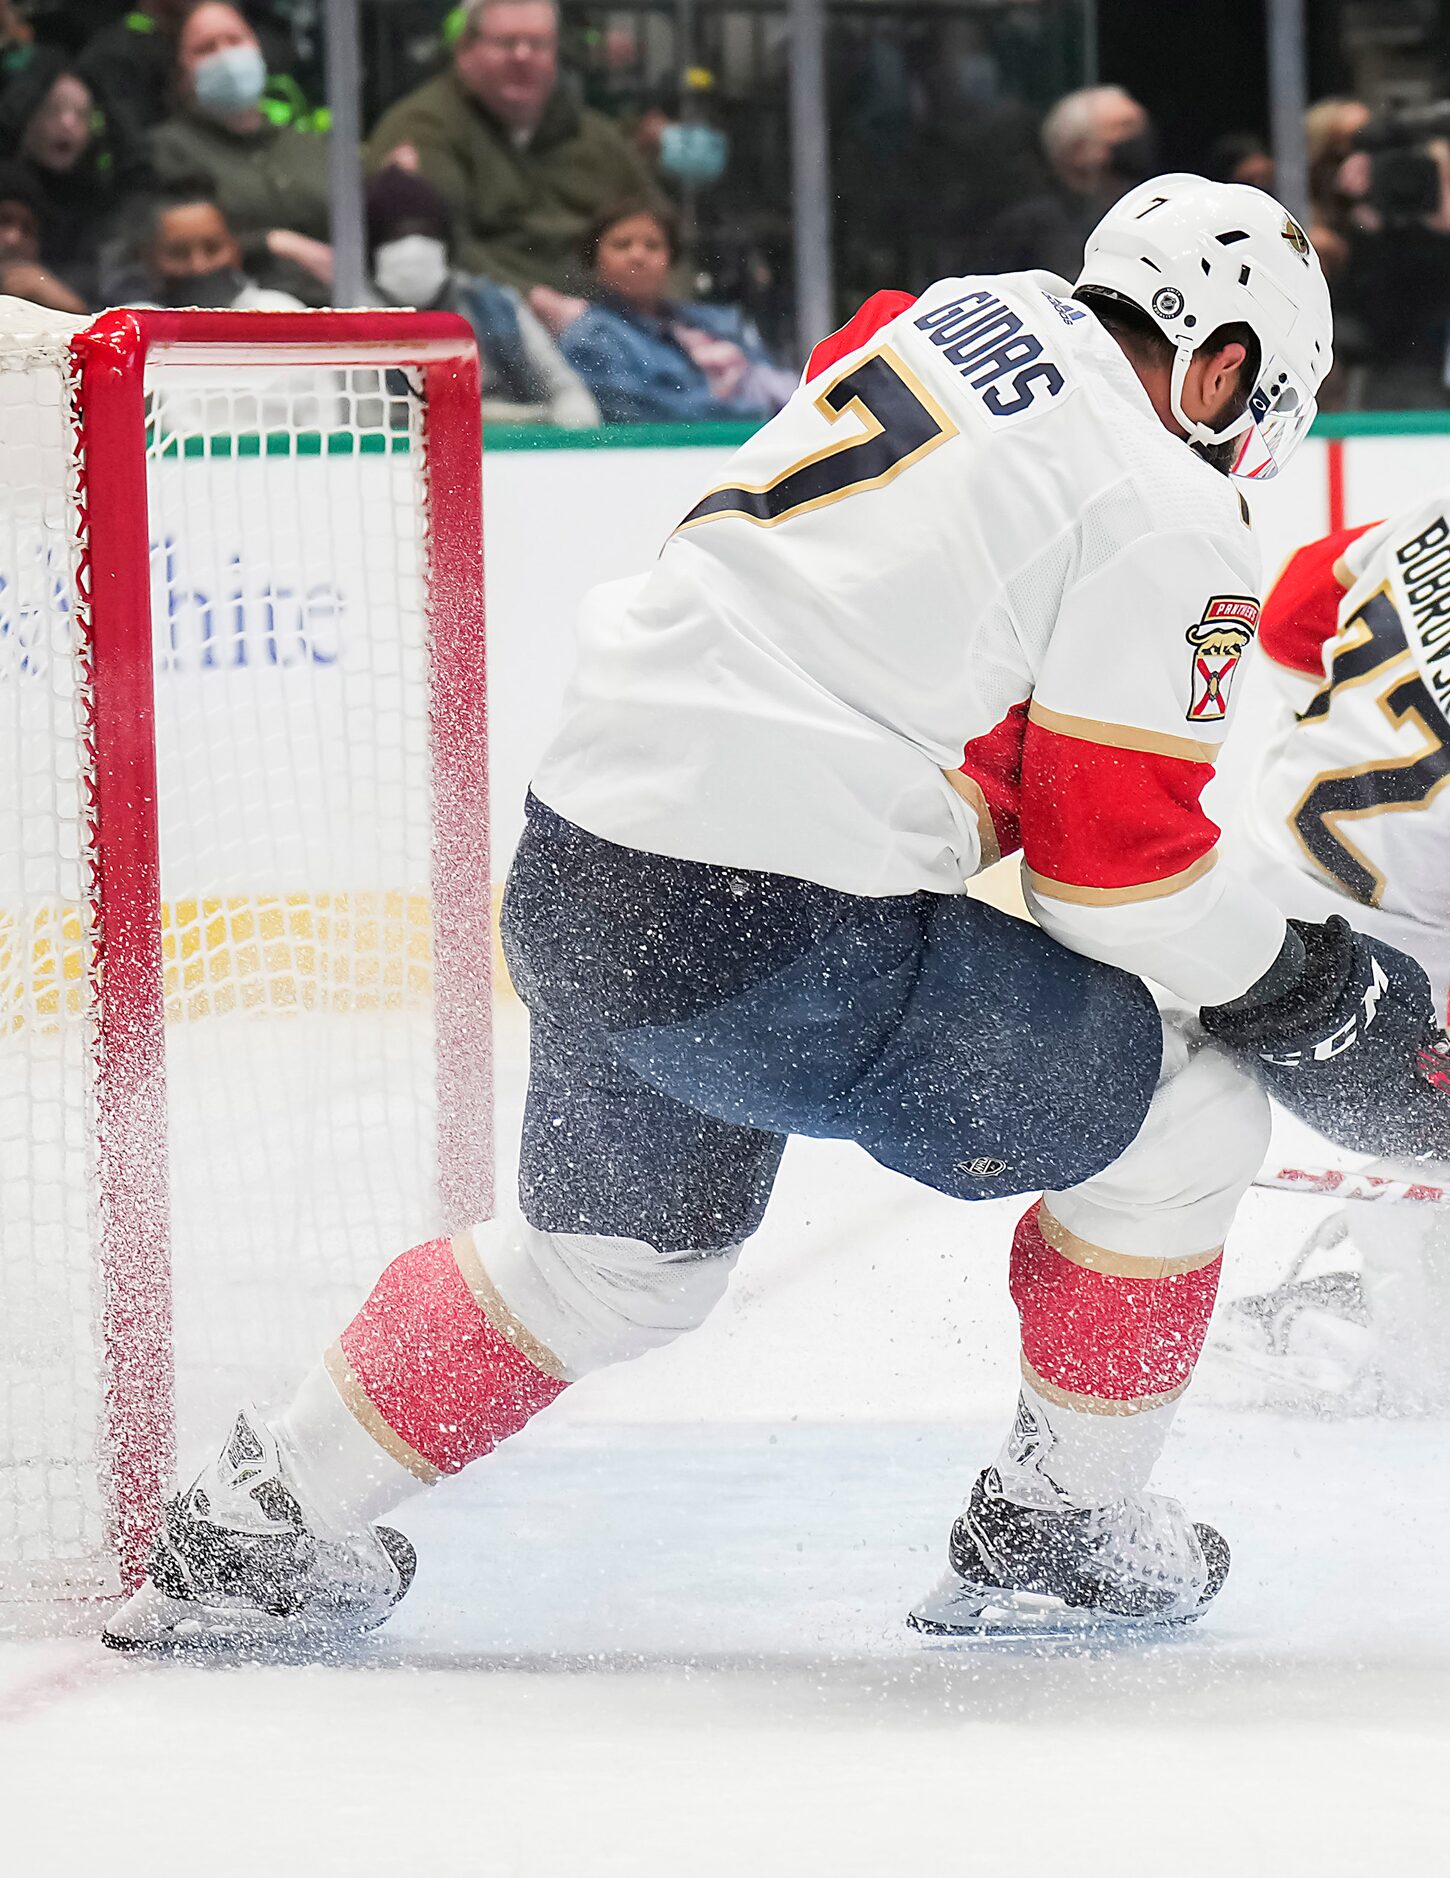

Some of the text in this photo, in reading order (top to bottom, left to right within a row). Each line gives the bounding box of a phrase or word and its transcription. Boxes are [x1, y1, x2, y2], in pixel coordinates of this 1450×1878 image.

[1135, 197, 1171, 219] 7
[913, 291, 1065, 416] GUDAS
[673, 343, 961, 530] 7
[1216, 603, 1257, 622] PANTHERS
